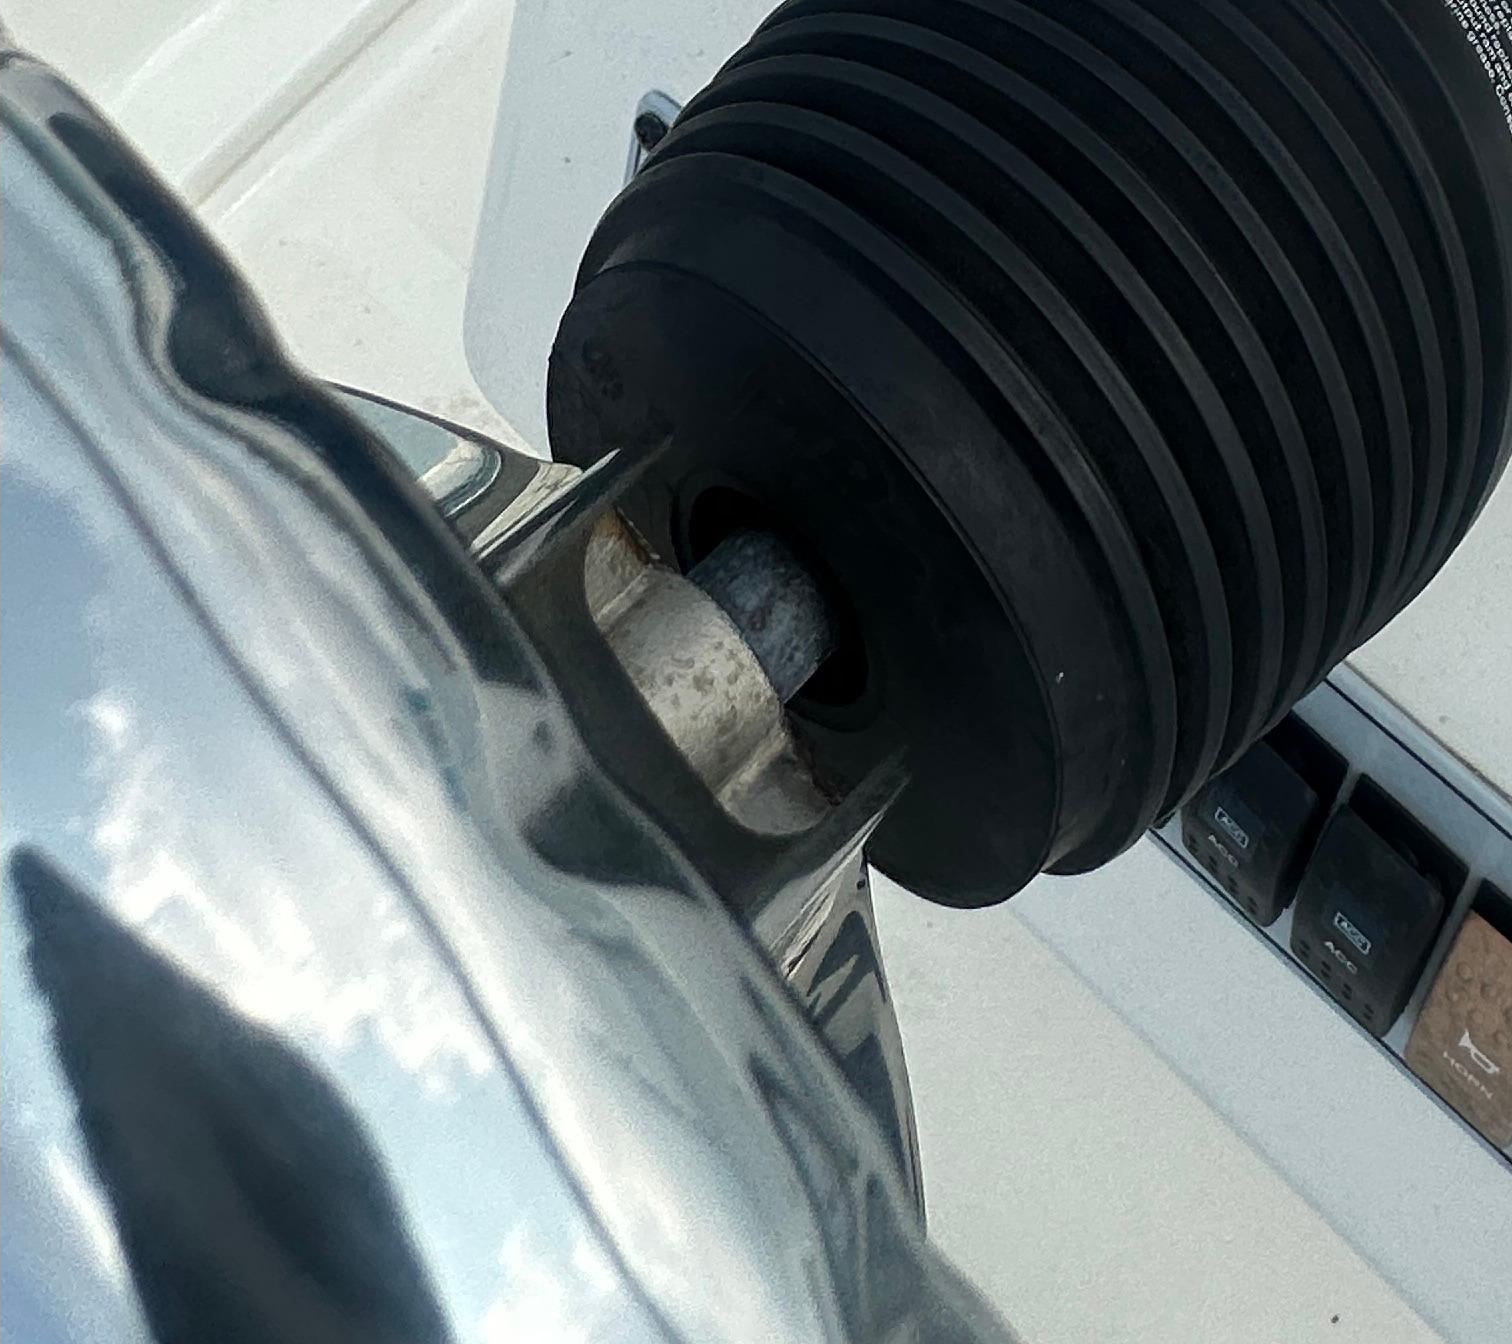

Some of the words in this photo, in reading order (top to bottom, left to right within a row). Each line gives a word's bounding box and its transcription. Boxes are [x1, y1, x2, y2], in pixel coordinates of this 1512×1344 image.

[1500, 0, 1512, 15] or
[1493, 62, 1512, 90] and
[1324, 940, 1358, 974] ACC
